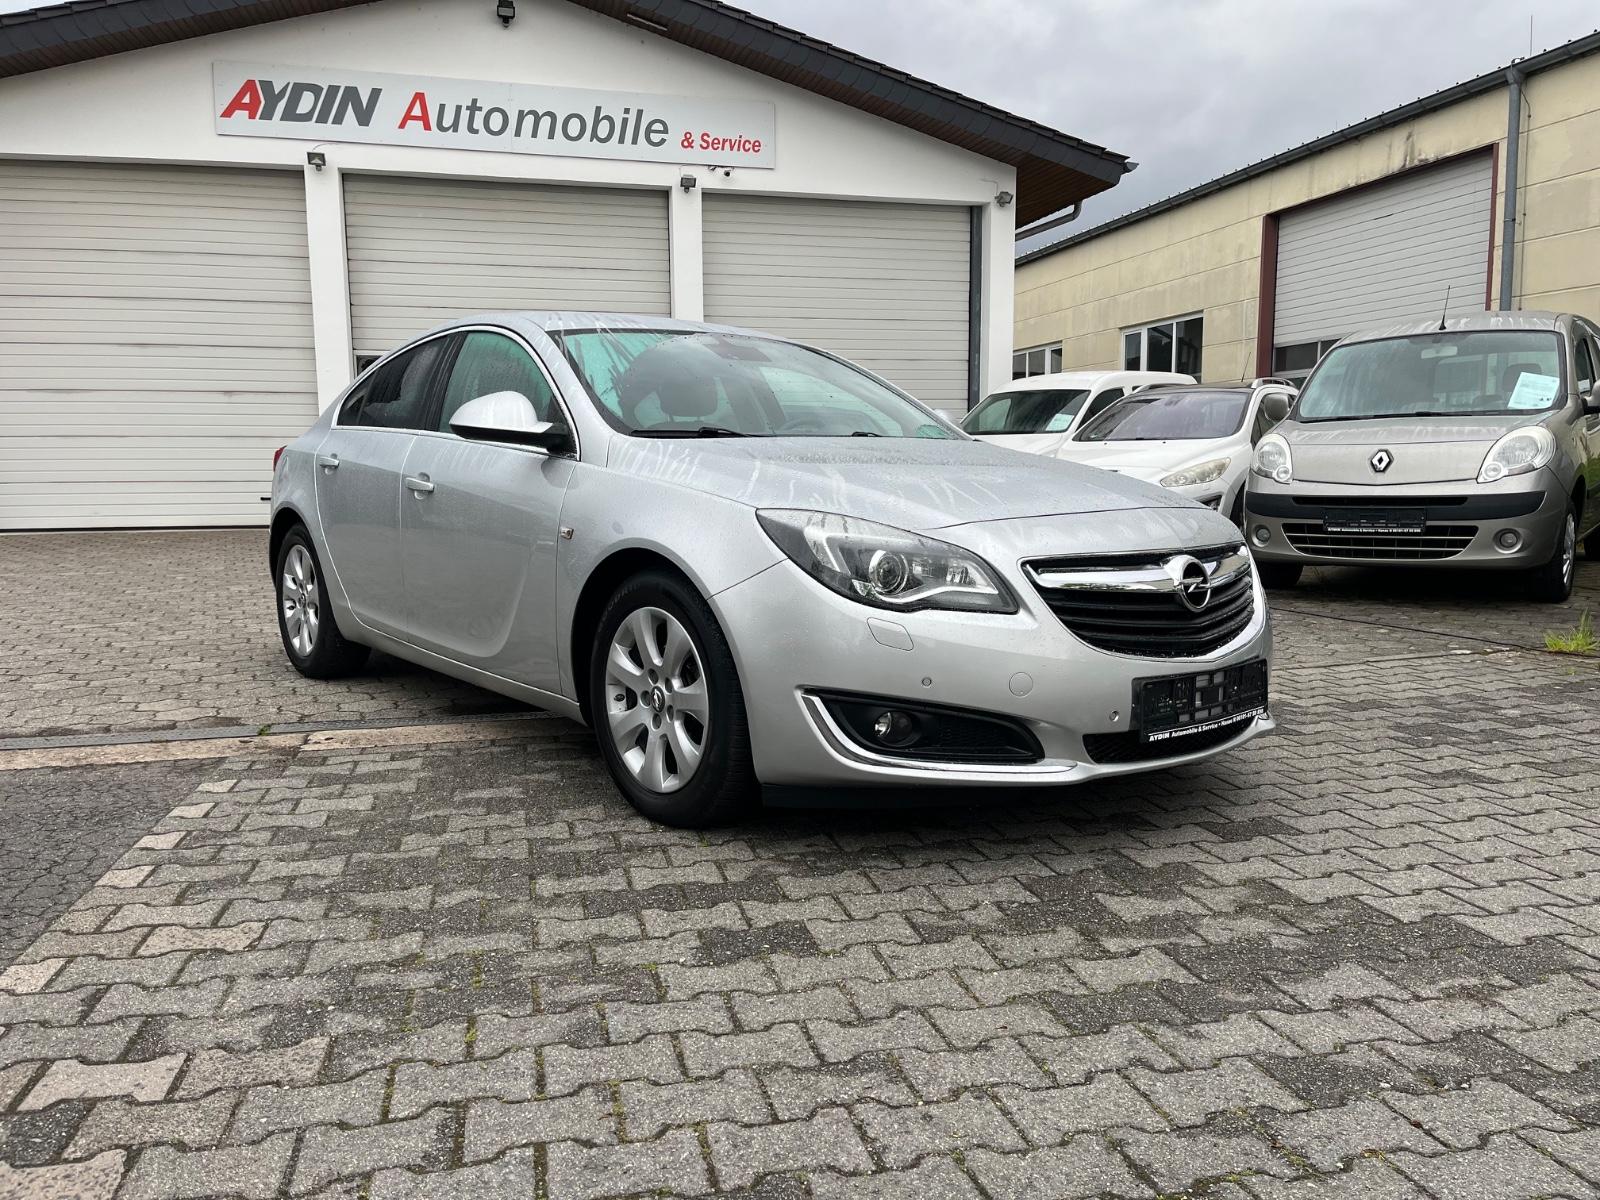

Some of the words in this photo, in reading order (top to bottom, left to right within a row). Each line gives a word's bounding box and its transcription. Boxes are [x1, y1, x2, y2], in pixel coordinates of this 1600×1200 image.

[220, 79, 382, 127] AYDIN
[398, 91, 669, 147] Automobile
[680, 131, 695, 149] &
[699, 132, 762, 153] Service
[1149, 733, 1170, 742] AYDIN
[1171, 729, 1198, 737] Automobile
[1202, 723, 1218, 731] Service
